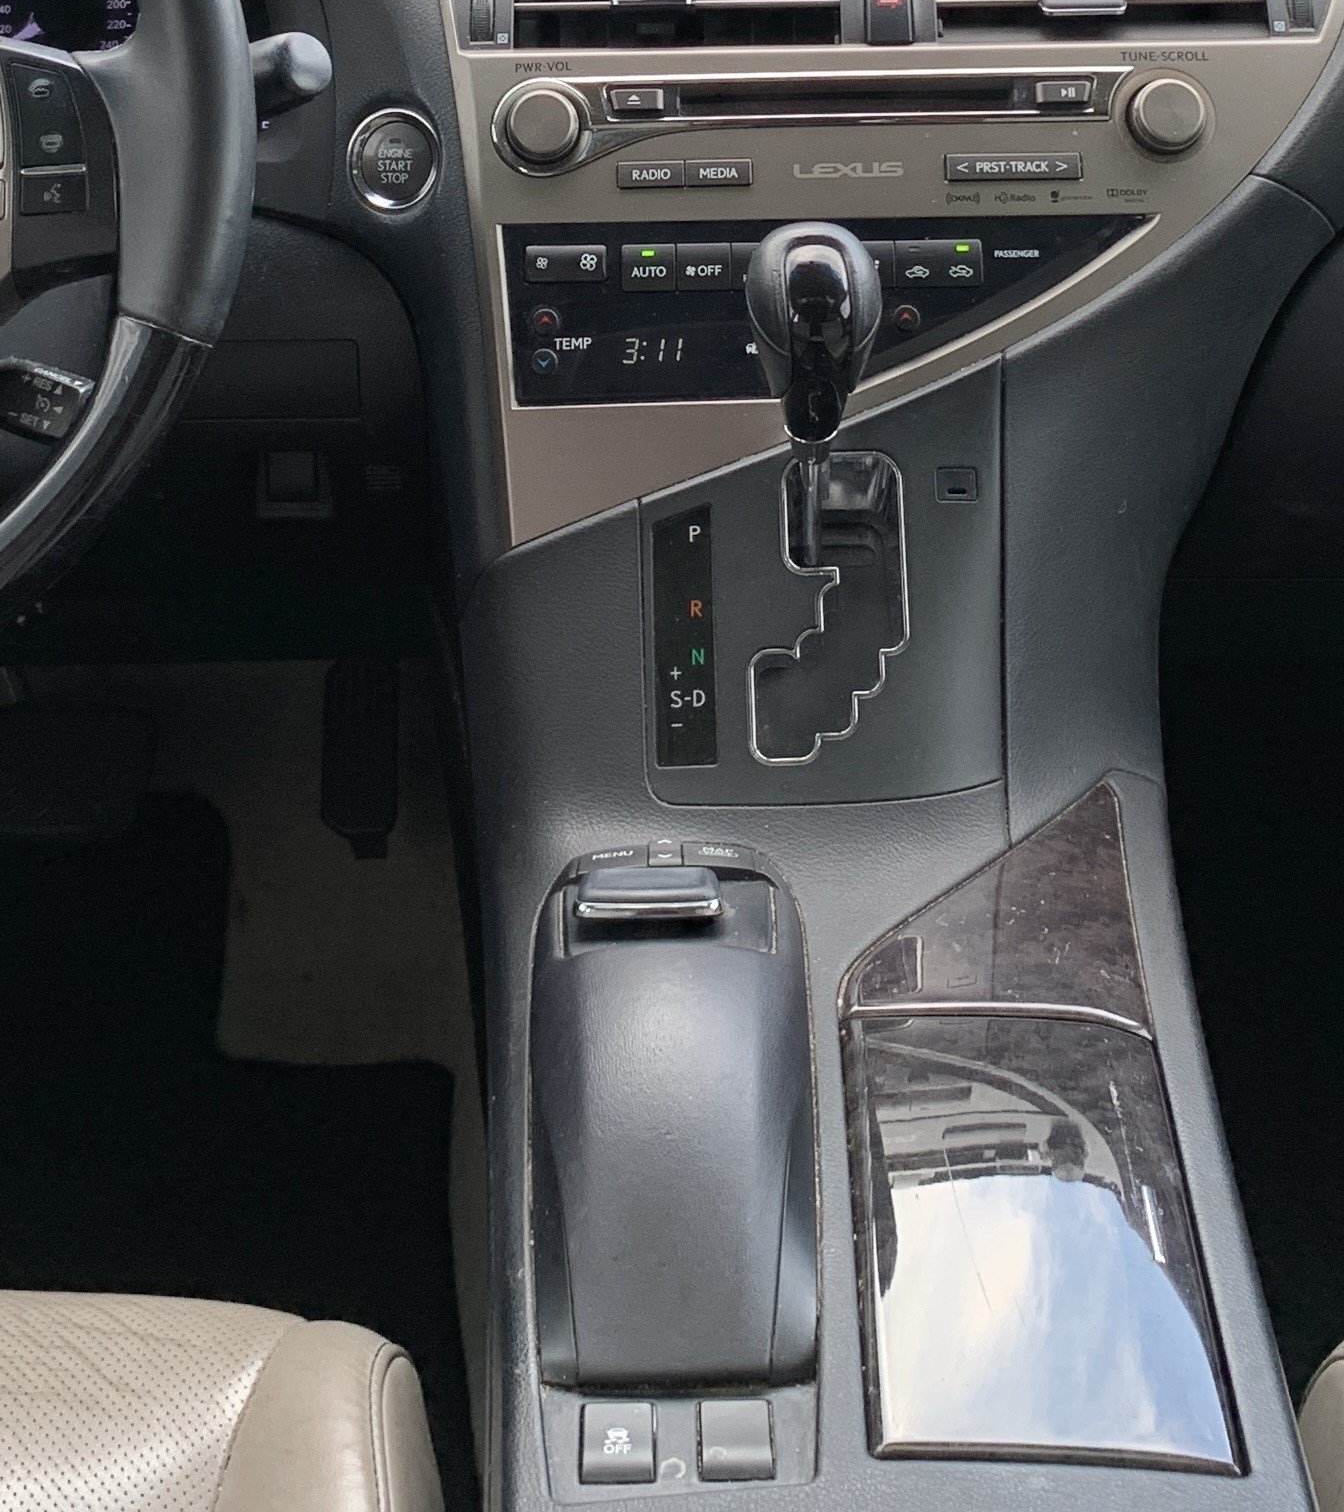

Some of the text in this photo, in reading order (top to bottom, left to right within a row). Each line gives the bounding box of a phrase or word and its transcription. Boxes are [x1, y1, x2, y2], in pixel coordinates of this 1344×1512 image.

[106, 0, 125, 9] 200
[106, 20, 125, 30] 220
[377, 148, 413, 158] ENGINE
[377, 160, 413, 171] START
[793, 161, 904, 178] LEXUS
[380, 172, 409, 184] STOP
[632, 168, 671, 180] RADIO
[699, 167, 738, 179] MEDIA
[1009, 193, 1036, 202] Radio
[994, 249, 1040, 258] PASSENGER
[630, 266, 667, 277] AUTO
[697, 265, 722, 276] OFF
[554, 337, 592, 350] TEMP
[623, 338, 683, 364] 3:11
[688, 525, 701, 543] P
[690, 599, 702, 617] R
[691, 648, 705, 665] N
[592, 850, 634, 860] MENU
[603, 1443, 632, 1454] OFF
